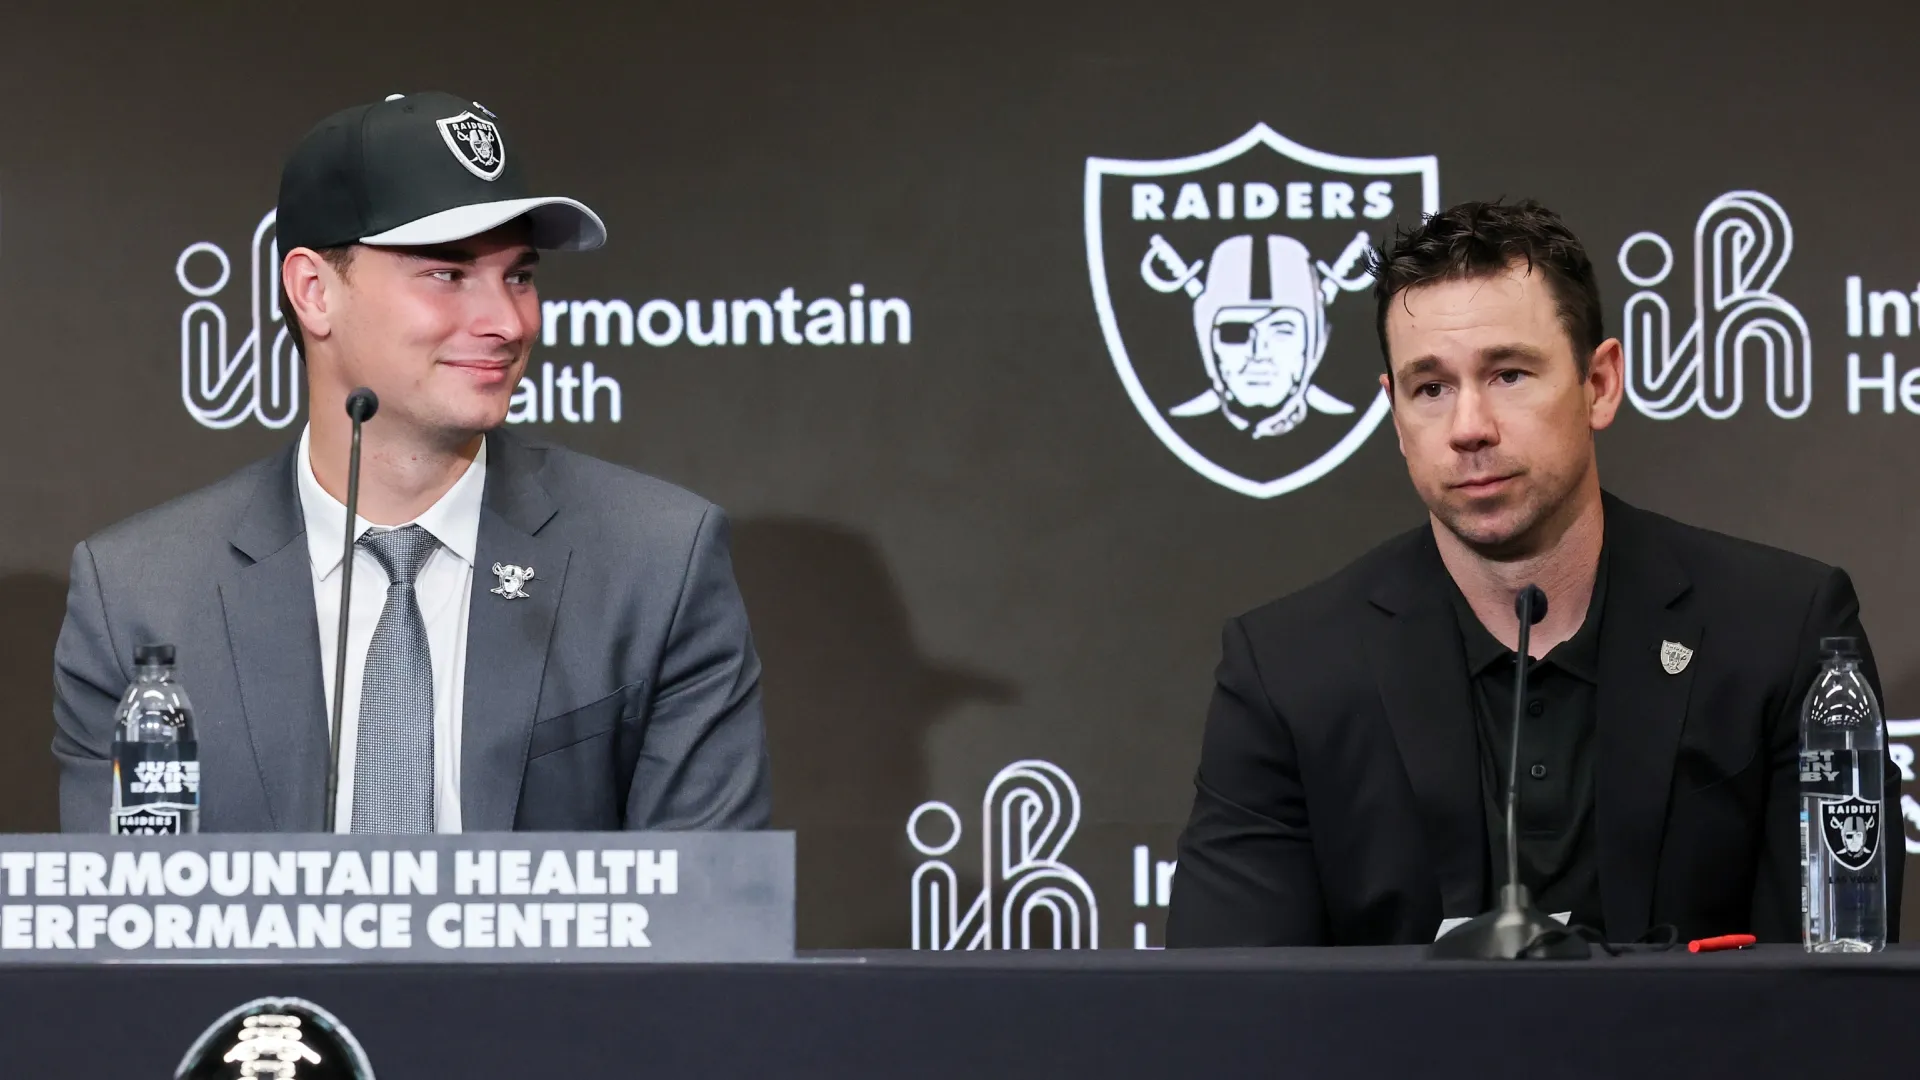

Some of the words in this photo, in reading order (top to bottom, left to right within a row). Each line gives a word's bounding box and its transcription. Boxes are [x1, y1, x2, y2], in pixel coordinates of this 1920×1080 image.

[452, 122, 492, 131] RAIDERS
[1132, 181, 1394, 220] RAIDERS
[541, 284, 911, 347] rmountain
[1846, 275, 1920, 337] In
[505, 361, 621, 424] alth
[120, 816, 172, 826] RAIDERS
[1828, 805, 1876, 814] RAIDERS
[0, 850, 438, 897] TERMOUNTAIN
[454, 849, 679, 896] HEALTH
[0, 903, 412, 950] ERFORMANCE
[426, 902, 652, 949] CENTER
